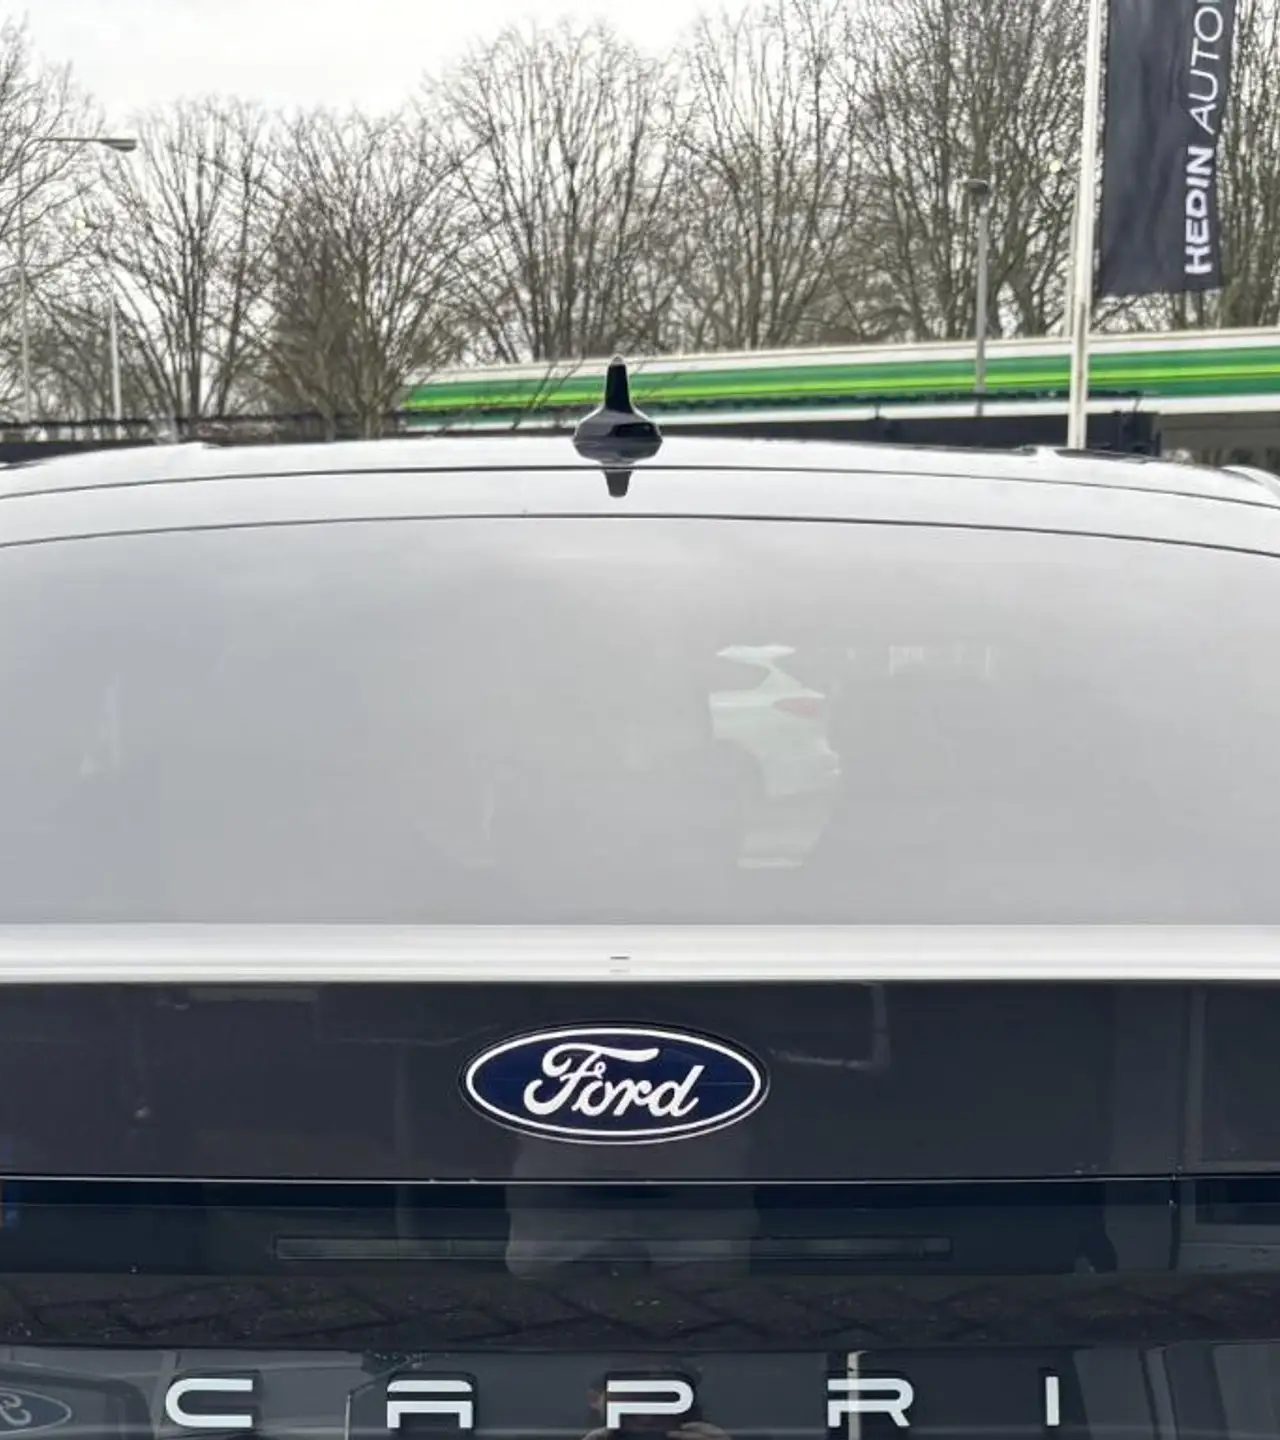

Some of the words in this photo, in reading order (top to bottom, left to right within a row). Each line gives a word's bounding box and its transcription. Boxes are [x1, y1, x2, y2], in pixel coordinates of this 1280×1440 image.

[1188, 0, 1224, 136] AUTO
[1184, 145, 1215, 275] HEDIN
[523, 1042, 705, 1118] Ford
[165, 1377, 1060, 1429] CAPRI
